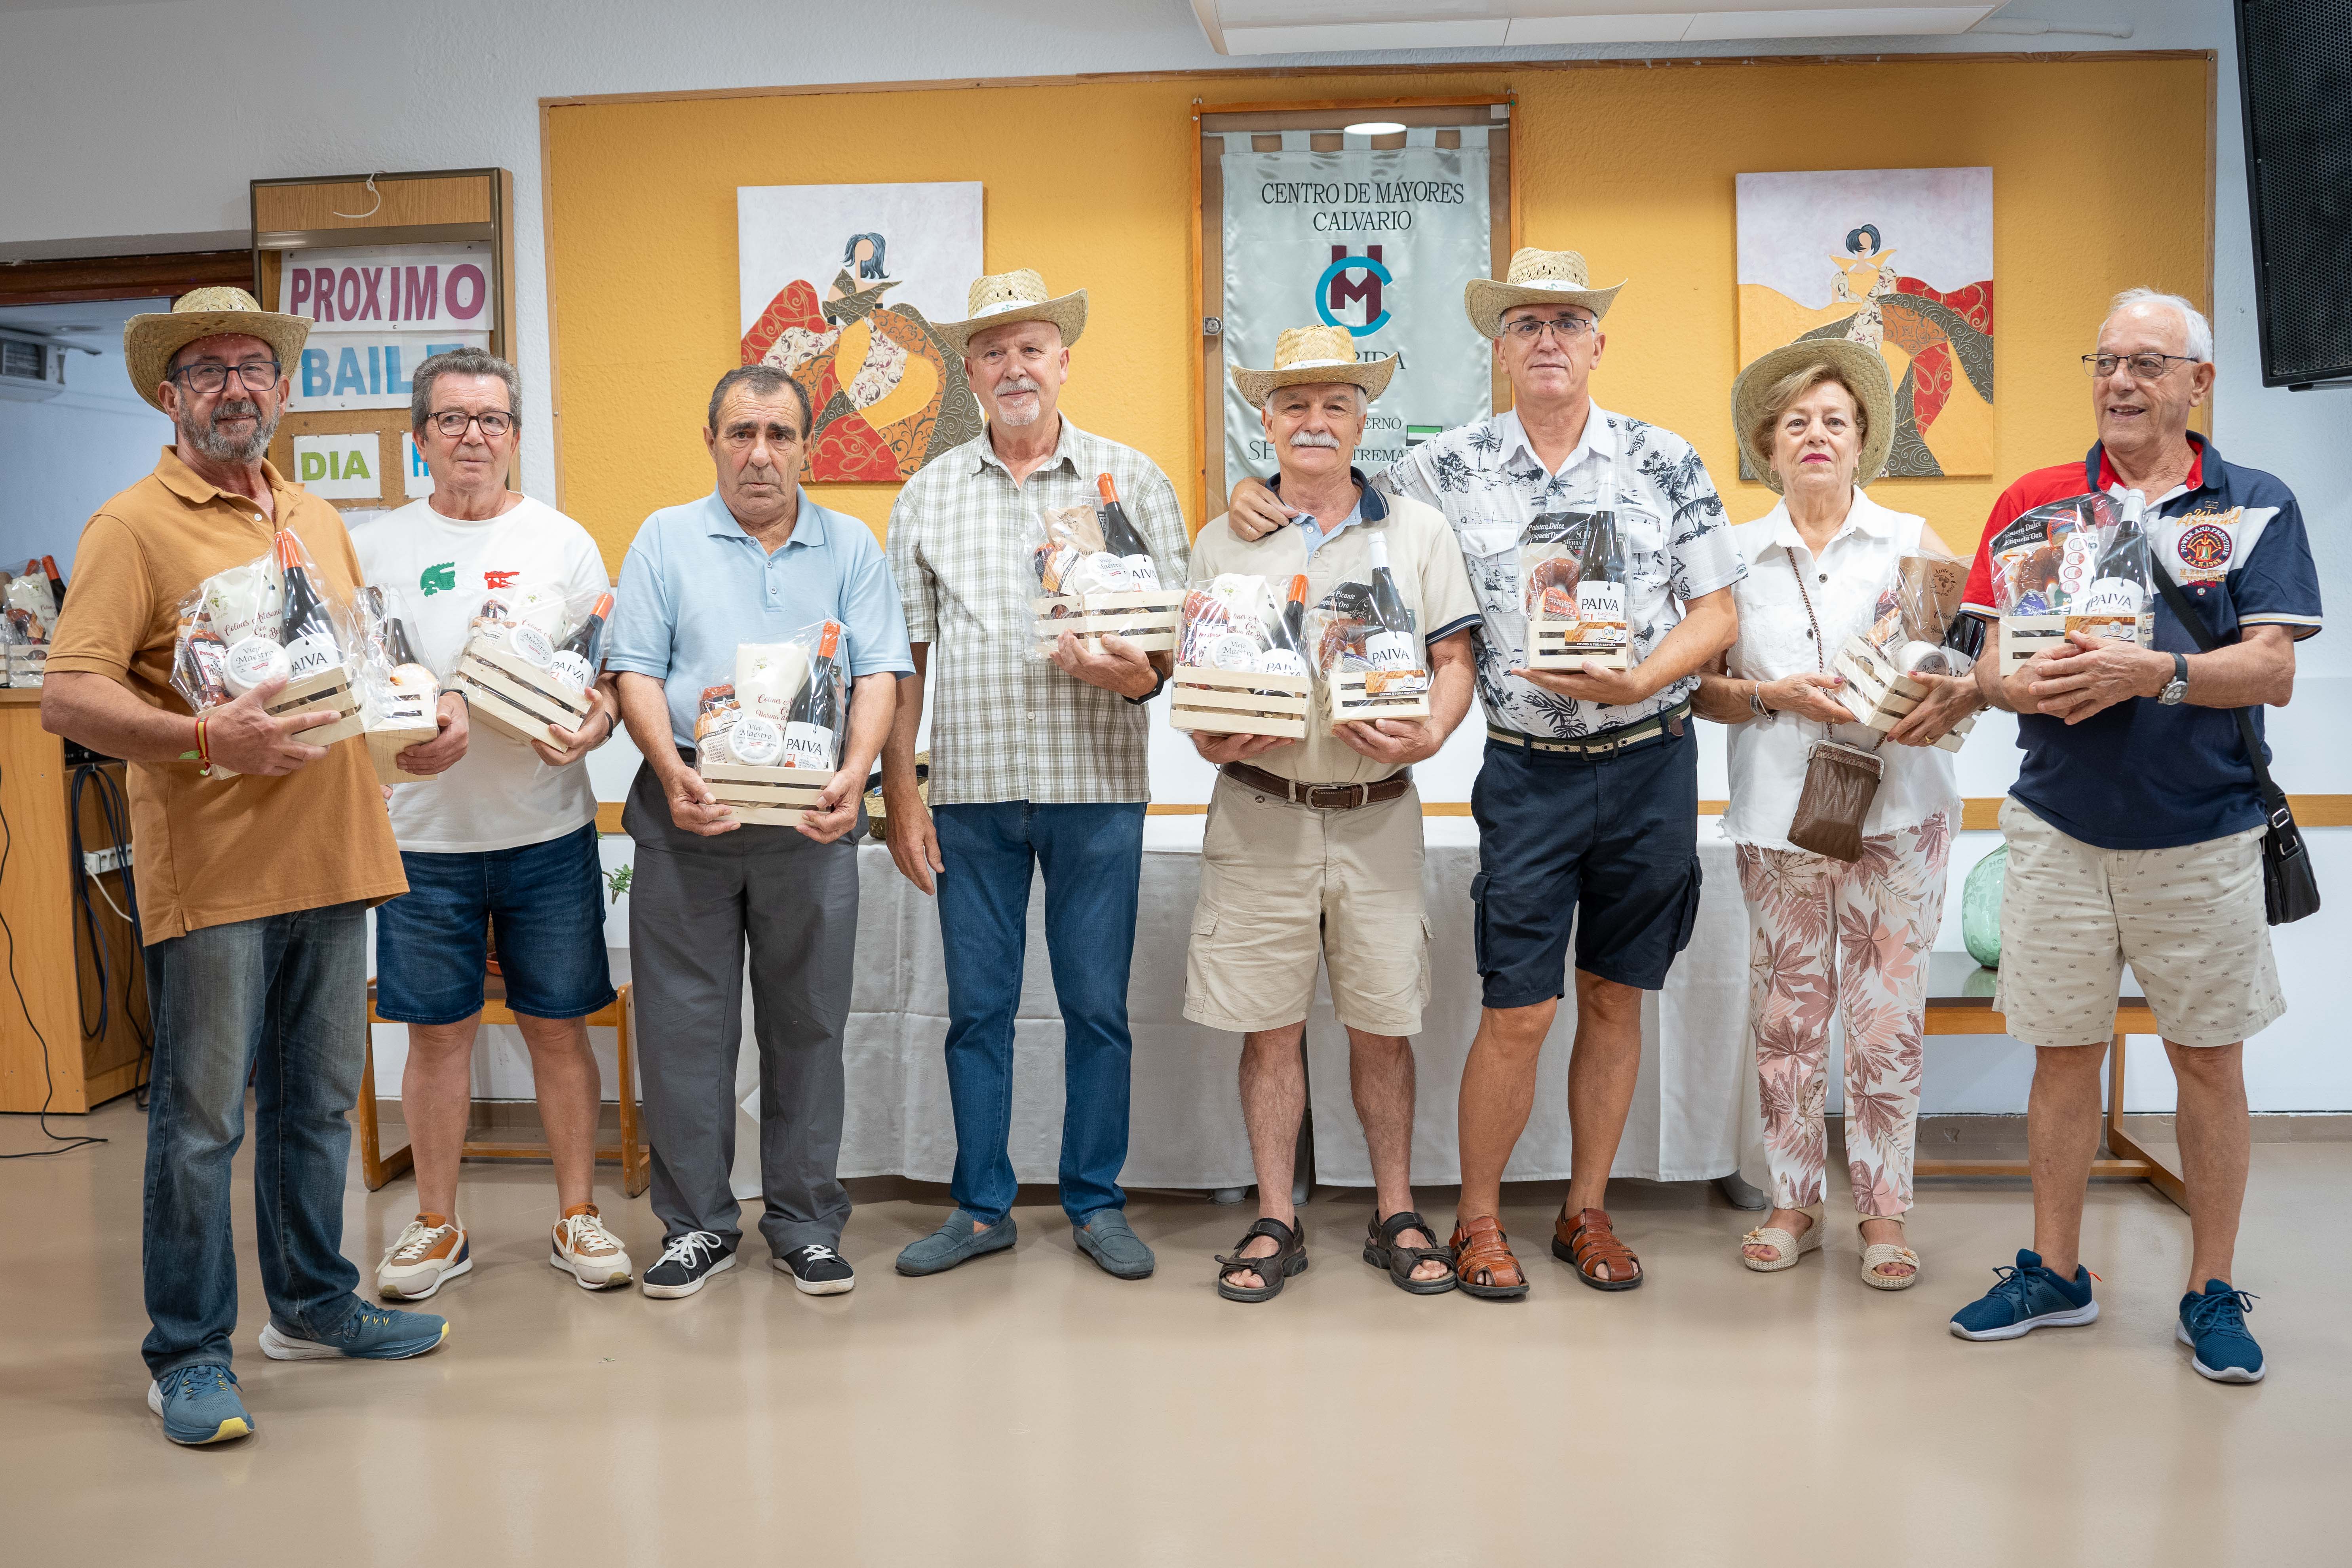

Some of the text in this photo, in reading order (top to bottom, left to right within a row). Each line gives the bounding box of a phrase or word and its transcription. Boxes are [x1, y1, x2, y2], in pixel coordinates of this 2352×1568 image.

[1261, 181, 1464, 204] CENTRO DE MAYORES
[1313, 211, 1412, 231] CALVARIO
[290, 264, 486, 322] PROXIMO
[301, 344, 464, 397] BAIL
[1363, 418, 1402, 430] ERNO
[300, 450, 371, 481] DIA
[2176, 509, 2241, 526] Around
[2194, 506, 2234, 519] World
[1098, 513, 1107, 533] Iber
[1529, 523, 1548, 532] Patatera
[2025, 521, 2042, 532] Dulce
[2005, 534, 2030, 546] Etiqueta
[2181, 532, 2194, 553] POWER
[1133, 568, 1158, 581] AIVA
[1335, 591, 1356, 600] Picante
[2090, 593, 2131, 608] PAIVA
[1339, 601, 1349, 609] Oro
[1582, 598, 1619, 612] PAIVA
[224, 608, 283, 636] Colines Artesanos
[254, 625, 267, 635] Con
[523, 632, 549, 656] Maestro
[533, 634, 545, 646] Viejo
[236, 650, 274, 664] Maestro
[1372, 648, 1409, 663] PAIVA
[551, 661, 584, 684] PAIVA
[758, 694, 781, 704] Colines
[755, 709, 780, 720] Harina
[739, 729, 772, 739] Maestro
[749, 724, 764, 732] Viejo
[786, 739, 821, 756] PAIVA
